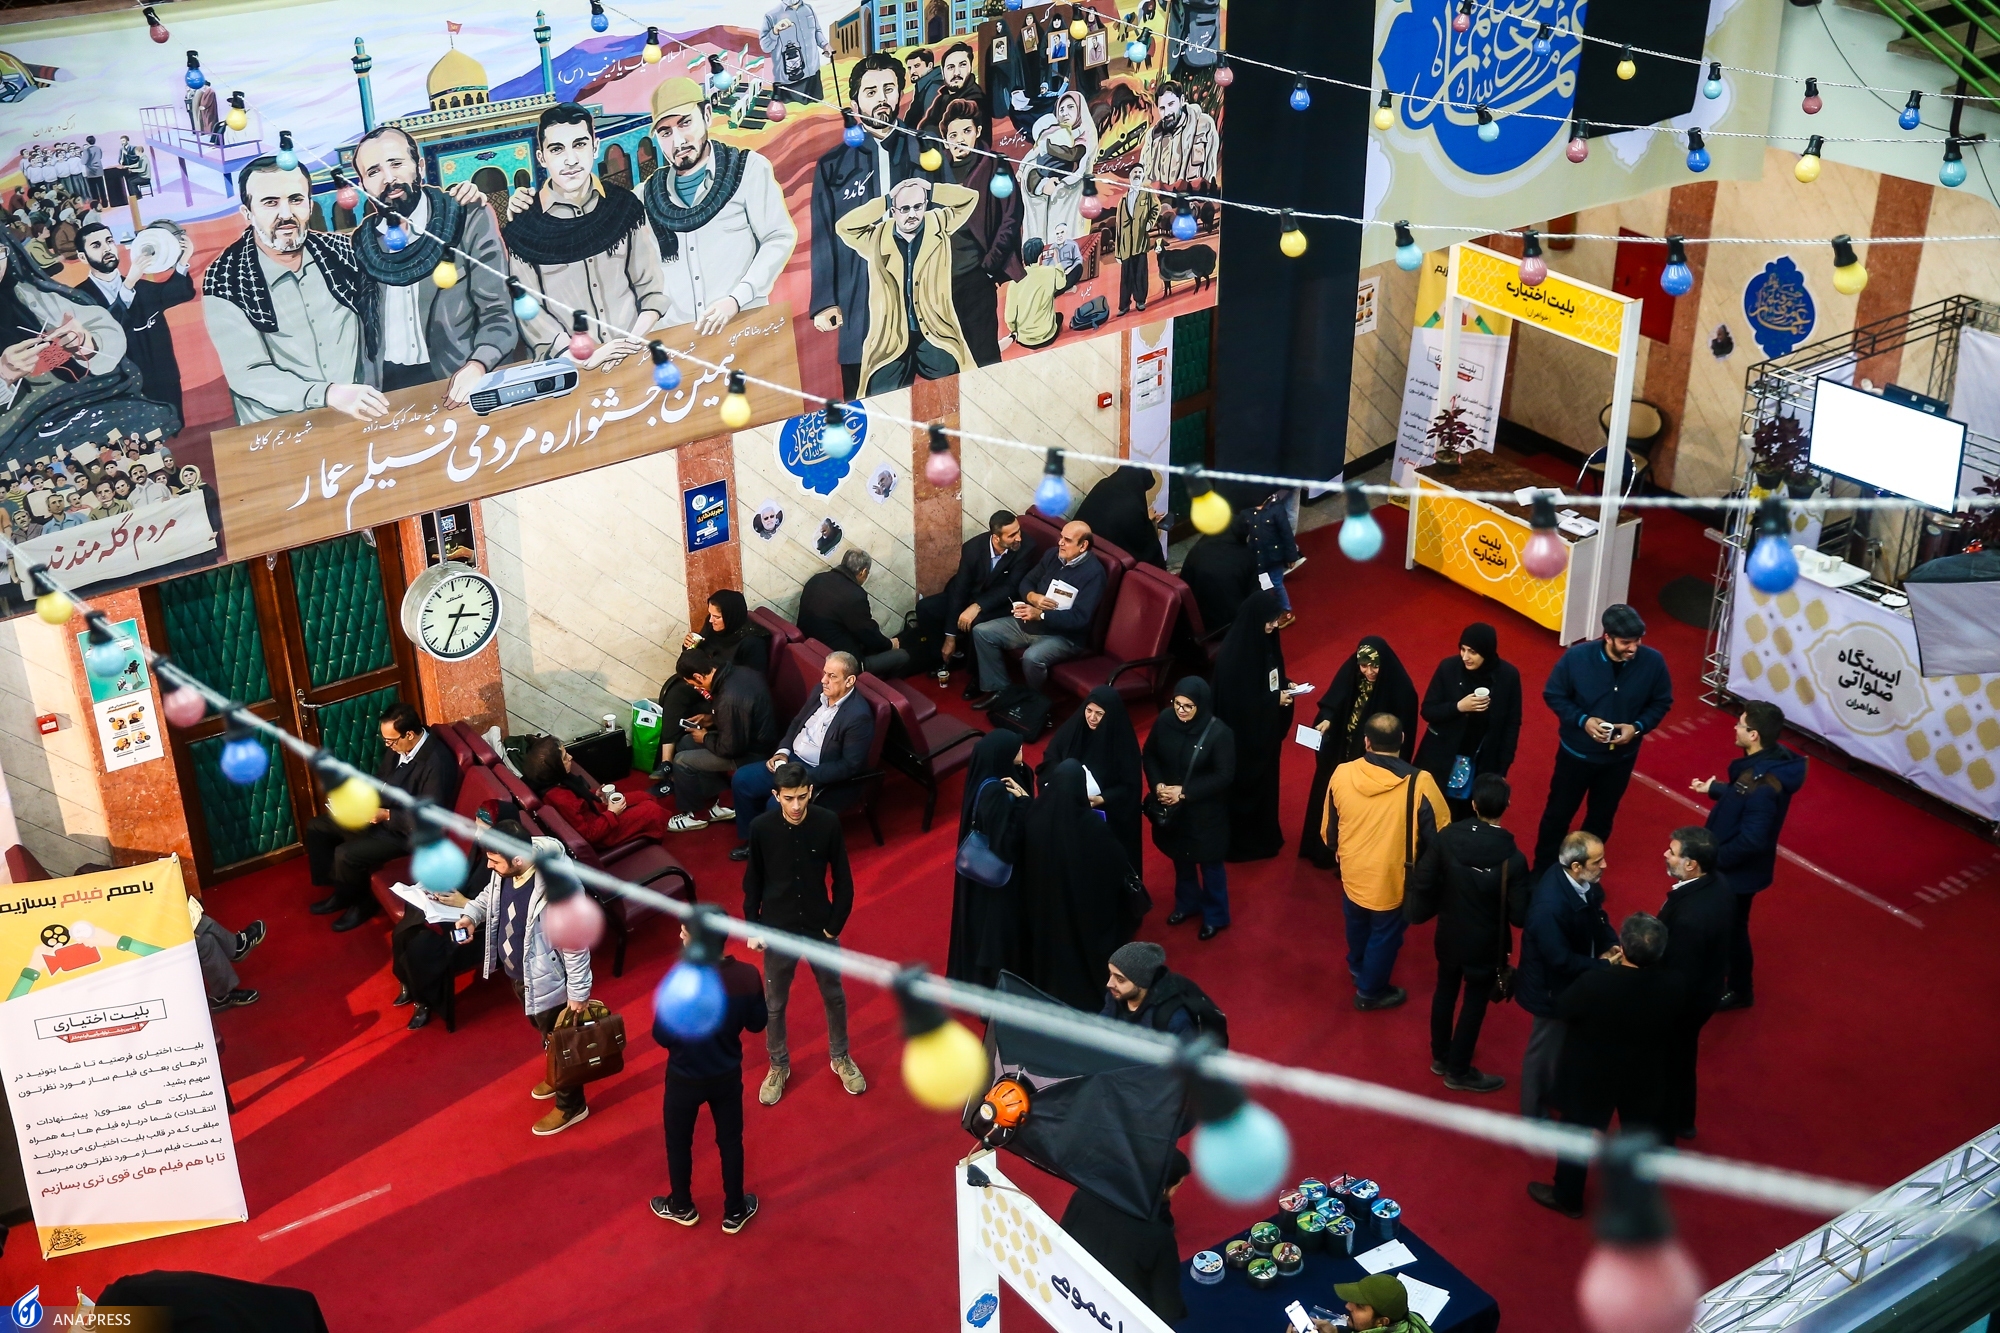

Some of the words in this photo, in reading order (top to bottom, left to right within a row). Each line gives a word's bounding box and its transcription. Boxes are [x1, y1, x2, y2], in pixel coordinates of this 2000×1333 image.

[1506, 281, 1547, 304] اختیاری
[1547, 296, 1575, 318] بلیت
[379, 403, 416, 431] کوچک
[408, 412, 422, 423] حامد
[423, 404, 439, 422] شهید
[540, 386, 664, 454] جشنواره
[38, 408, 88, 438] عصمت
[362, 420, 379, 434] زاده
[293, 420, 313, 443] شهید
[249, 429, 273, 451] کابلی
[272, 429, 292, 451] رحیم
[447, 423, 537, 483] مردمی
[346, 418, 458, 531] فیلم
[286, 458, 354, 511] عمار
[98, 512, 134, 564] گله
[133, 518, 177, 560] مردم
[1478, 533, 1502, 551] بلیت
[1473, 547, 1508, 569] اختیاری
[1837, 648, 1902, 686] ایستگاه
[1838, 671, 1894, 702] صلواتی
[1845, 698, 1881, 716] خواهران
[106, 884, 141, 901] هم
[142, 880, 154, 894] با
[60, 887, 103, 908] فیلم
[109, 1005, 150, 1021] بلیت
[53, 1011, 107, 1032] اختیاری
[135, 1046, 172, 1061] اختیاری
[174, 1041, 204, 1052] بلیت
[83, 1059, 96, 1067] تا
[98, 1052, 133, 1065] فرصتیه
[171, 1057, 208, 1071] اثرهای
[26, 1067, 57, 1078] بتونید
[59, 1062, 81, 1072] شما
[139, 1065, 170, 1077] بعدی
[14, 1073, 23, 1082] در
[88, 1075, 110, 1086] ساز
[112, 1068, 138, 1081] فیلم
[188, 1075, 211, 1085] سهیم
[59, 1080, 86, 1090] مورد
[163, 1078, 187, 1088] بشید.
[18, 1083, 57, 1098] نظرتون
[168, 1090, 214, 1103] مشارکت
[137, 1099, 163, 1110] های
[36, 1112, 88, 1126] پیشنهادات
[120, 1117, 148, 1129] درباره
[149, 1112, 172, 1122] شما
[77, 1127, 93, 1135] ها
[95, 1121, 119, 1134] فیلم
[146, 1129, 166, 1139] قالب
[176, 1125, 190, 1133] که
[191, 1121, 220, 1133] مبلغی
[29, 1134, 58, 1145] همراه
[84, 1137, 119, 1152] اختیاری
[120, 1133, 145, 1143] بلیت
[182, 1138, 209, 1148] دست
[33, 1149, 69, 1160] پردازید
[70, 1146, 83, 1155] می
[141, 1148, 163, 1158] ساز
[164, 1143, 181, 1154] فیلم
[75, 1155, 113, 1170] نظرتون
[114, 1152, 140, 1162] مورد
[205, 1154, 214, 1166] با
[216, 1152, 226, 1161] تا
[36, 1163, 74, 1175] میرسه
[159, 1159, 183, 1175] فیلم
[185, 1158, 204, 1170] هم
[106, 1169, 130, 1184] قوی
[132, 1166, 157, 1180] های
[82, 1174, 105, 1189] تری
[41, 1181, 80, 1197] بسازیم
